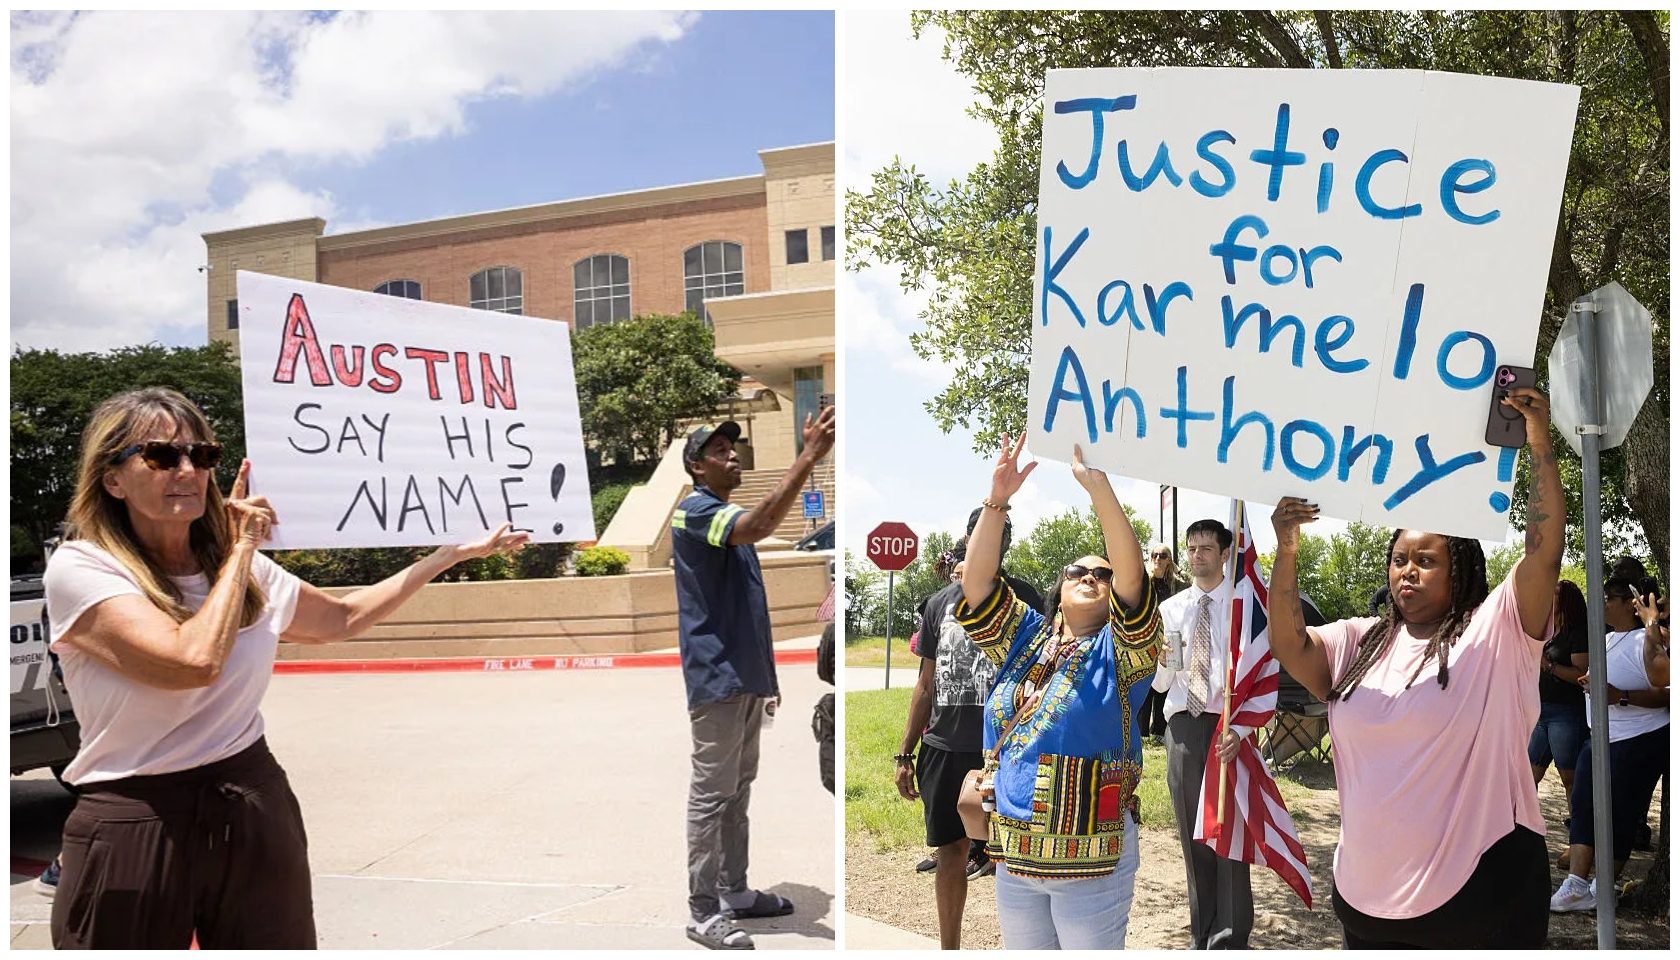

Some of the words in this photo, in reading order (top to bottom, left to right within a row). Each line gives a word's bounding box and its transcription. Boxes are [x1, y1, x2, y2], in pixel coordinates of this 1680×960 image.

[1054, 94, 1500, 225] Justice
[1209, 214, 1342, 289] for
[288, 403, 390, 463] SAY
[441, 415, 533, 470] HIS
[1043, 345, 1519, 514] Anthony!
[336, 463, 566, 536] NAME!
[870, 536, 915, 556] STOP
[509, 658, 534, 669] LANE
